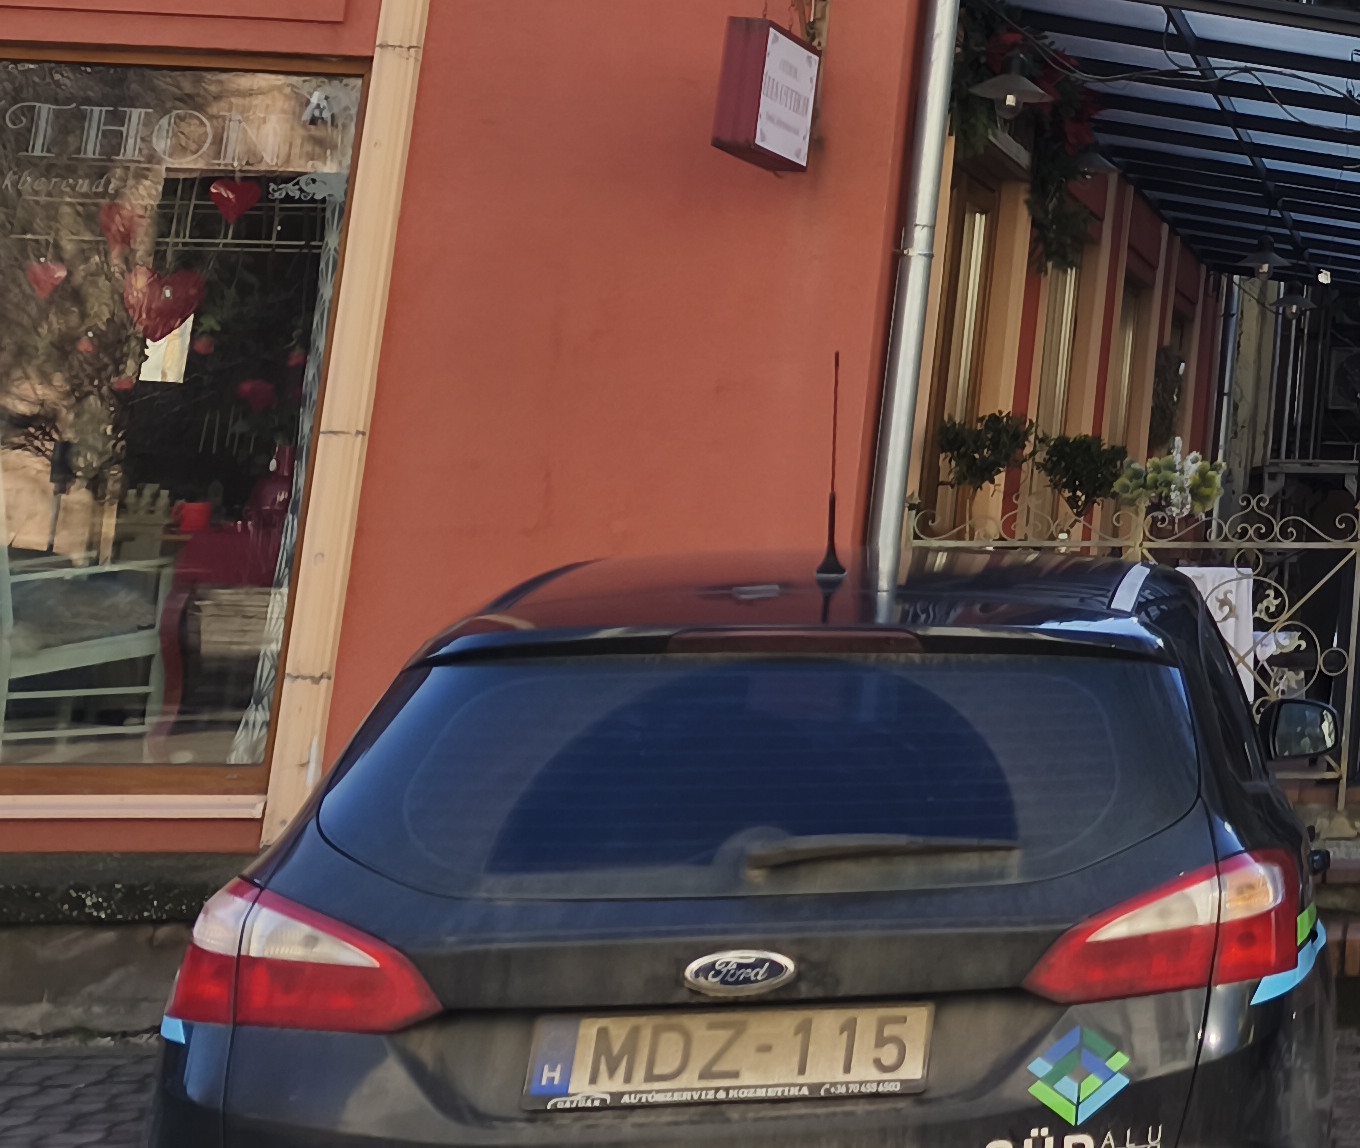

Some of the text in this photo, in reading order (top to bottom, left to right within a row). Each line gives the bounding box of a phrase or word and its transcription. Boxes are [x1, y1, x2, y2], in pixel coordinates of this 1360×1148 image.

[707, 957, 771, 984] Ford
[541, 1015, 908, 1086] H MDZ-115
[728, 1084, 810, 1099] KOZMETIKA
